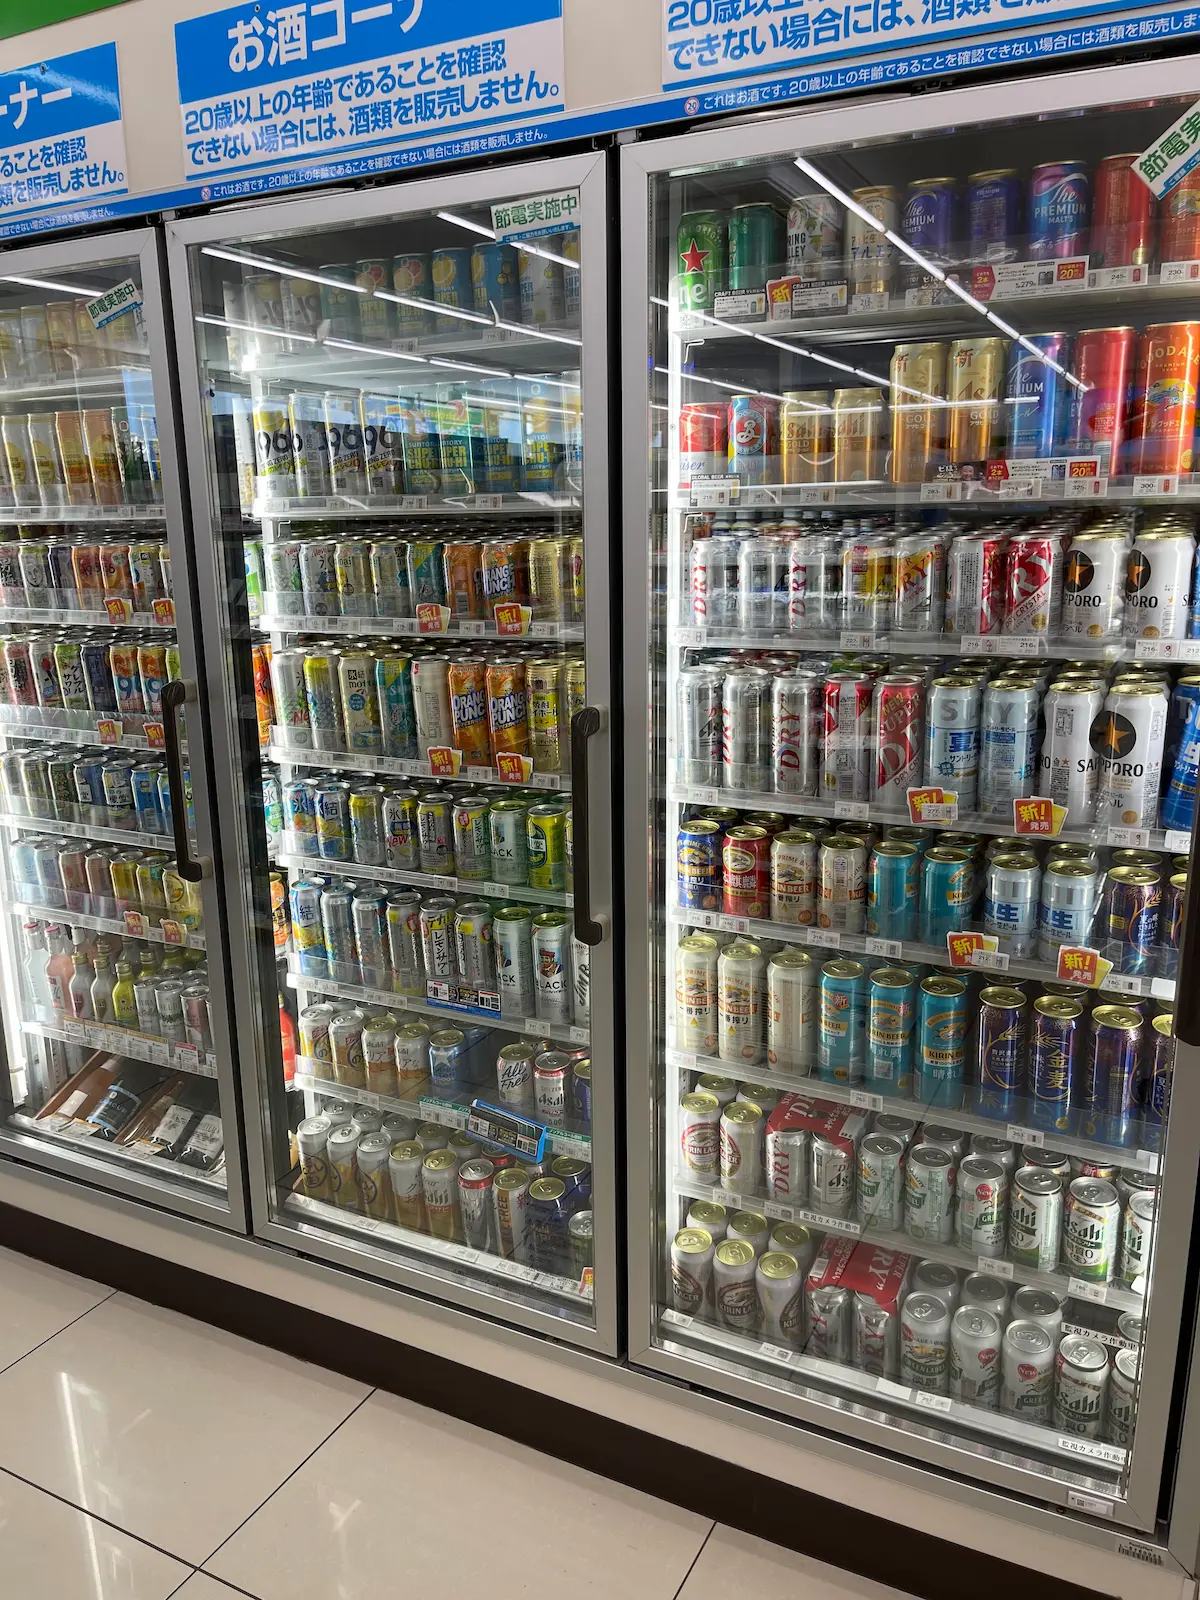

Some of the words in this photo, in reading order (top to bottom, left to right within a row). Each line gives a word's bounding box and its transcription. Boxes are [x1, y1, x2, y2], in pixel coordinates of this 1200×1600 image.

[704, 14, 1200, 110] これはお酒です。20歳以上の年齢であることを確認できない場合には酒類を販売しま
[185, 38, 507, 138] 20歳以上の年齢であることを確認
[0, 80, 72, 130] ナー
[186, 69, 559, 170] できない場合には、酒類を販売しません。
[1049, 184, 1078, 205] The
[494, 194, 578, 229] 節電実施中
[905, 204, 924, 219] The
[1034, 203, 1087, 220] PREMIUM
[88, 283, 135, 319] 節電実施中
[772, 284, 791, 303] 新
[954, 349, 976, 368] 新
[407, 447, 436, 459] SUPE
[107, 602, 123, 617] 新!
[155, 602, 171, 617] 新!
[419, 606, 438, 623] 新!
[498, 609, 517, 626] 新!
[453, 688, 486, 712] ORANG
[882, 692, 904, 716] NEW
[456, 702, 485, 725] PUNC
[99, 722, 113, 738] 新!
[146, 729, 162, 744] 新!
[431, 752, 449, 767] 新!
[502, 759, 519, 775] 新!
[1076, 756, 1144, 778] SAPPORO
[439, 764, 452, 773] 発売
[508, 772, 522, 780] 発売
[324, 801, 338, 818] 結
[388, 806, 402, 823] 氷
[1018, 799, 1046, 823] 新!
[1030, 821, 1050, 831] 発売
[386, 833, 409, 848] New
[691, 868, 712, 878] BEER
[788, 885, 810, 895] BEER
[299, 904, 315, 922] 結
[434, 929, 448, 977] レモンサワー
[952, 937, 978, 957] 新!
[1063, 951, 1092, 971] 新!
[1072, 969, 1093, 981] 発売
[886, 1029, 908, 1040] BEER
[928, 1051, 955, 1063] KIRIN
[502, 1062, 525, 1080] All
[1046, 1049, 1071, 1091] 金麦
[500, 1074, 531, 1091] Free
[1082, 1164, 1096, 1178] 新
[803, 1213, 860, 1236] 監視カメラ作動中
[1065, 1324, 1138, 1352] 監視カメラ作動中
[1018, 1368, 1036, 1380] New
